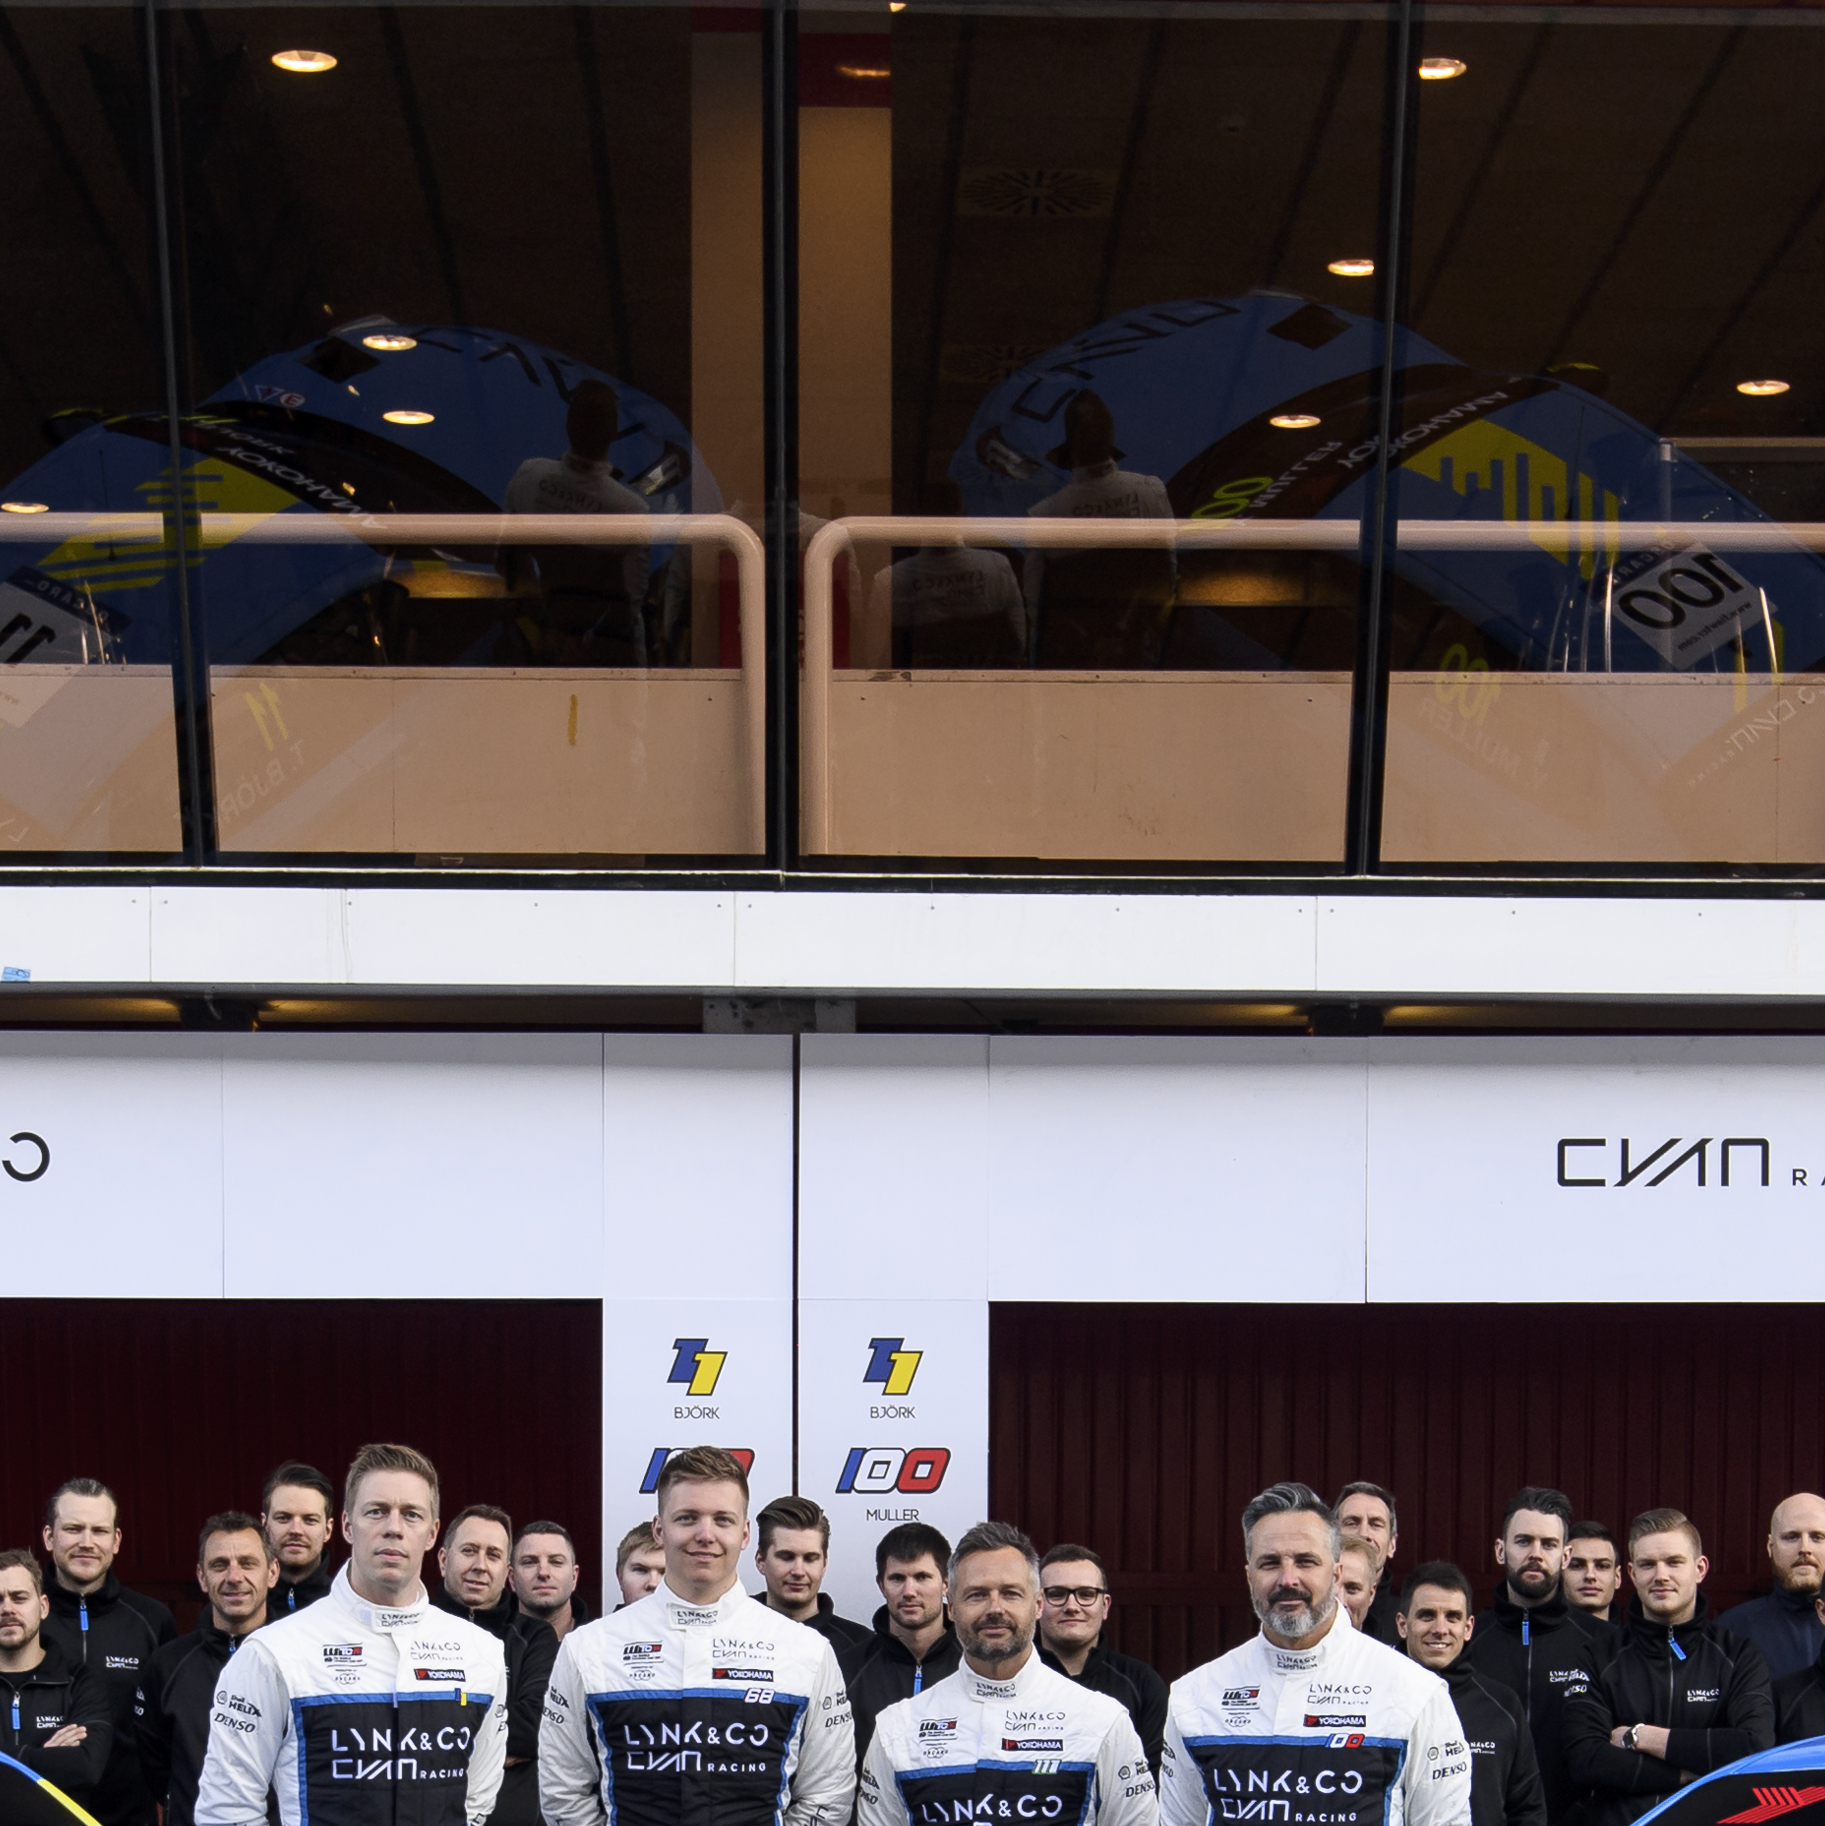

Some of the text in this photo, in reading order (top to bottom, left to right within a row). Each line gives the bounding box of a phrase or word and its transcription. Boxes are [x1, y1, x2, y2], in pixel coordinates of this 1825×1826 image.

[1557, 1137, 1770, 1187] CYAN
[667, 1338, 728, 1396] 11
[862, 1337, 923, 1396] 11
[674, 1405, 720, 1419] BJÖRK
[870, 1405, 916, 1419] BJÖRK
[835, 1447, 951, 1494] 100
[867, 1508, 919, 1522] MULLER
[428, 1670, 465, 1680] YOKOHAMA
[727, 1669, 772, 1680] YOKOHAMA
[744, 1688, 774, 1704] 68
[229, 1701, 262, 1717] HELIX
[214, 1712, 256, 1733] DENSO
[1319, 1717, 1364, 1725] YOKOHAMA
[332, 1726, 470, 1751] LYNK&CO
[624, 1721, 768, 1746] LYNK&CO
[1325, 1733, 1365, 1748] 100
[1017, 1741, 1061, 1750] YOKOHAMA
[332, 1758, 464, 1780] CYAN RACING
[627, 1750, 766, 1772] CYAN RACING
[1032, 1759, 1061, 1775] 111
[1432, 1762, 1467, 1780] DENSO
[1213, 1769, 1363, 1794] LYNK&CO
[922, 1793, 1063, 1822] LYNK&CO
[1221, 1799, 1357, 1822] CYAN RACING
